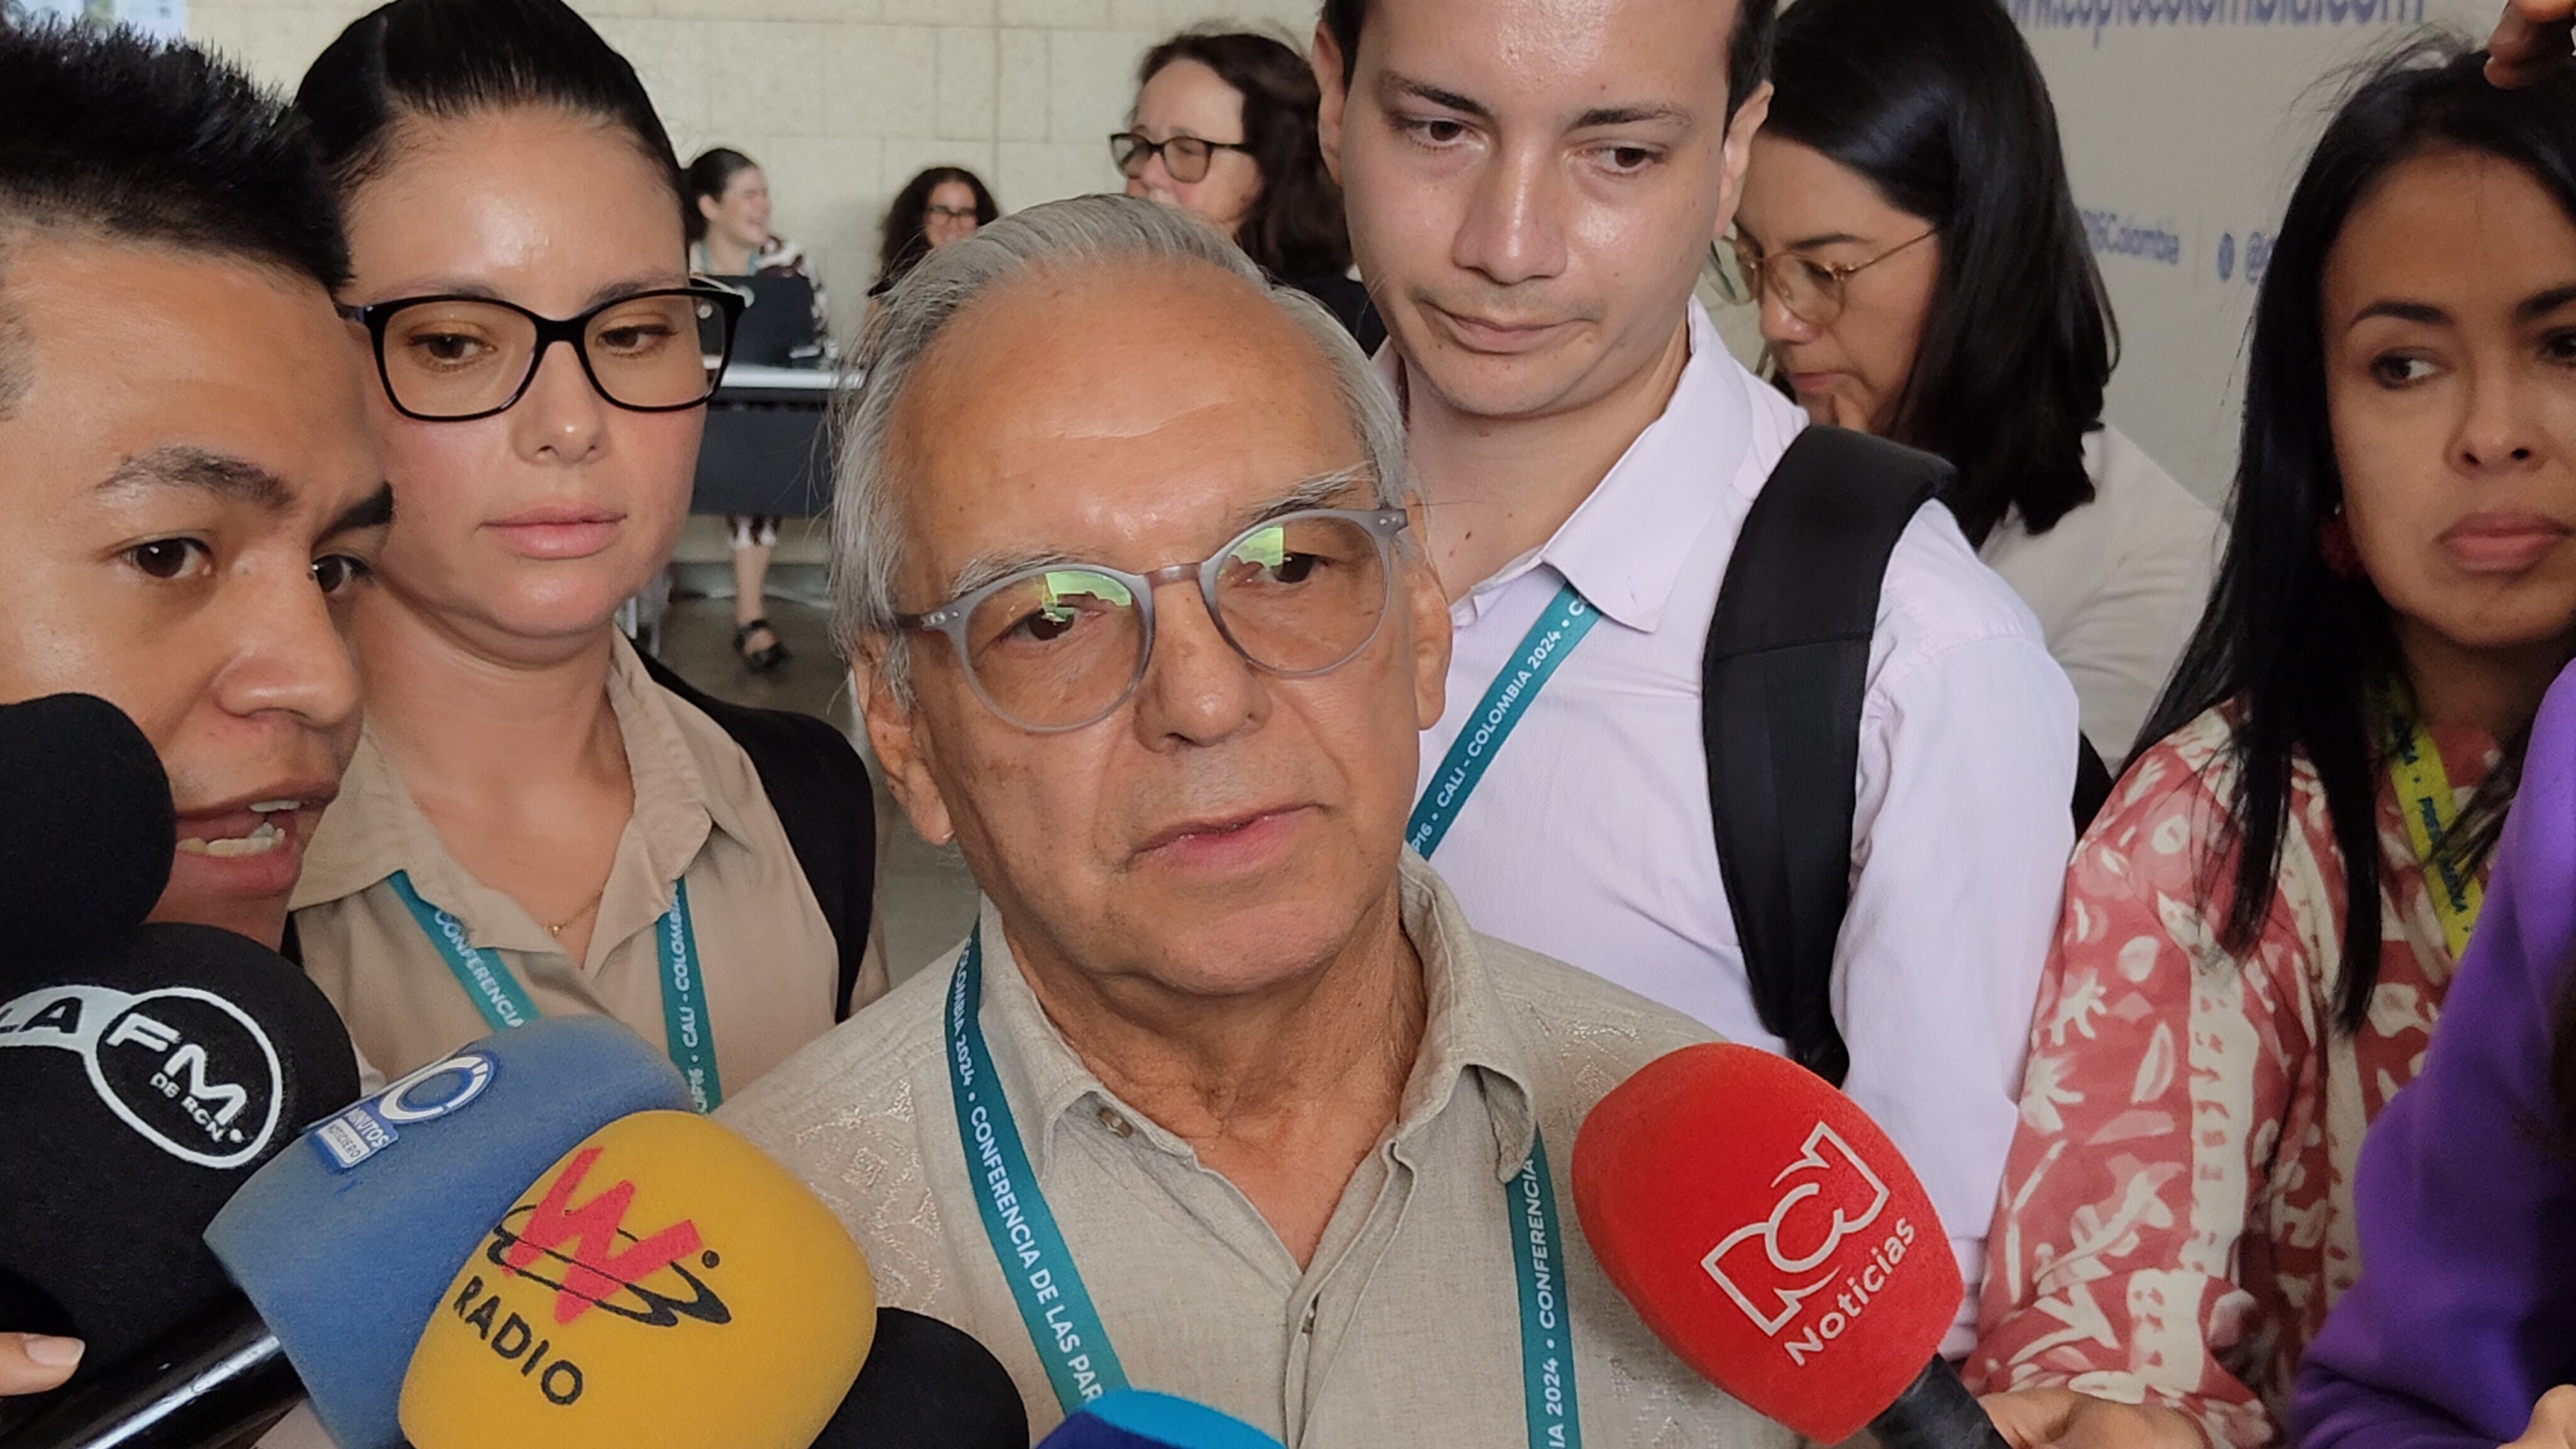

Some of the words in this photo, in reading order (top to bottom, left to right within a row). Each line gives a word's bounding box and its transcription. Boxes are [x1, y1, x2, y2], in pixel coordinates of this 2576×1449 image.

[1436, 767, 1465, 808] CALI
[1467, 669, 1532, 758] COLOMBIA
[1527, 630, 1562, 669] 2024
[434, 909, 525, 1028] CONFERENCIA
[680, 1006, 698, 1048] CALI
[106, 1013, 247, 1126] FM
[150, 1072, 180, 1099] DE
[181, 1096, 226, 1143] RCN
[955, 1034, 975, 1087] 2024
[970, 1106, 1041, 1269] CONFERENCIA
[1030, 1269, 1059, 1305] DE
[1045, 1305, 1081, 1353] LAS
[1521, 1157, 1556, 1330] CONFERENCIA
[453, 1275, 584, 1406] RADIO
[1784, 1217, 1916, 1367] Noticias
[1543, 1357, 1563, 1417] 2024
